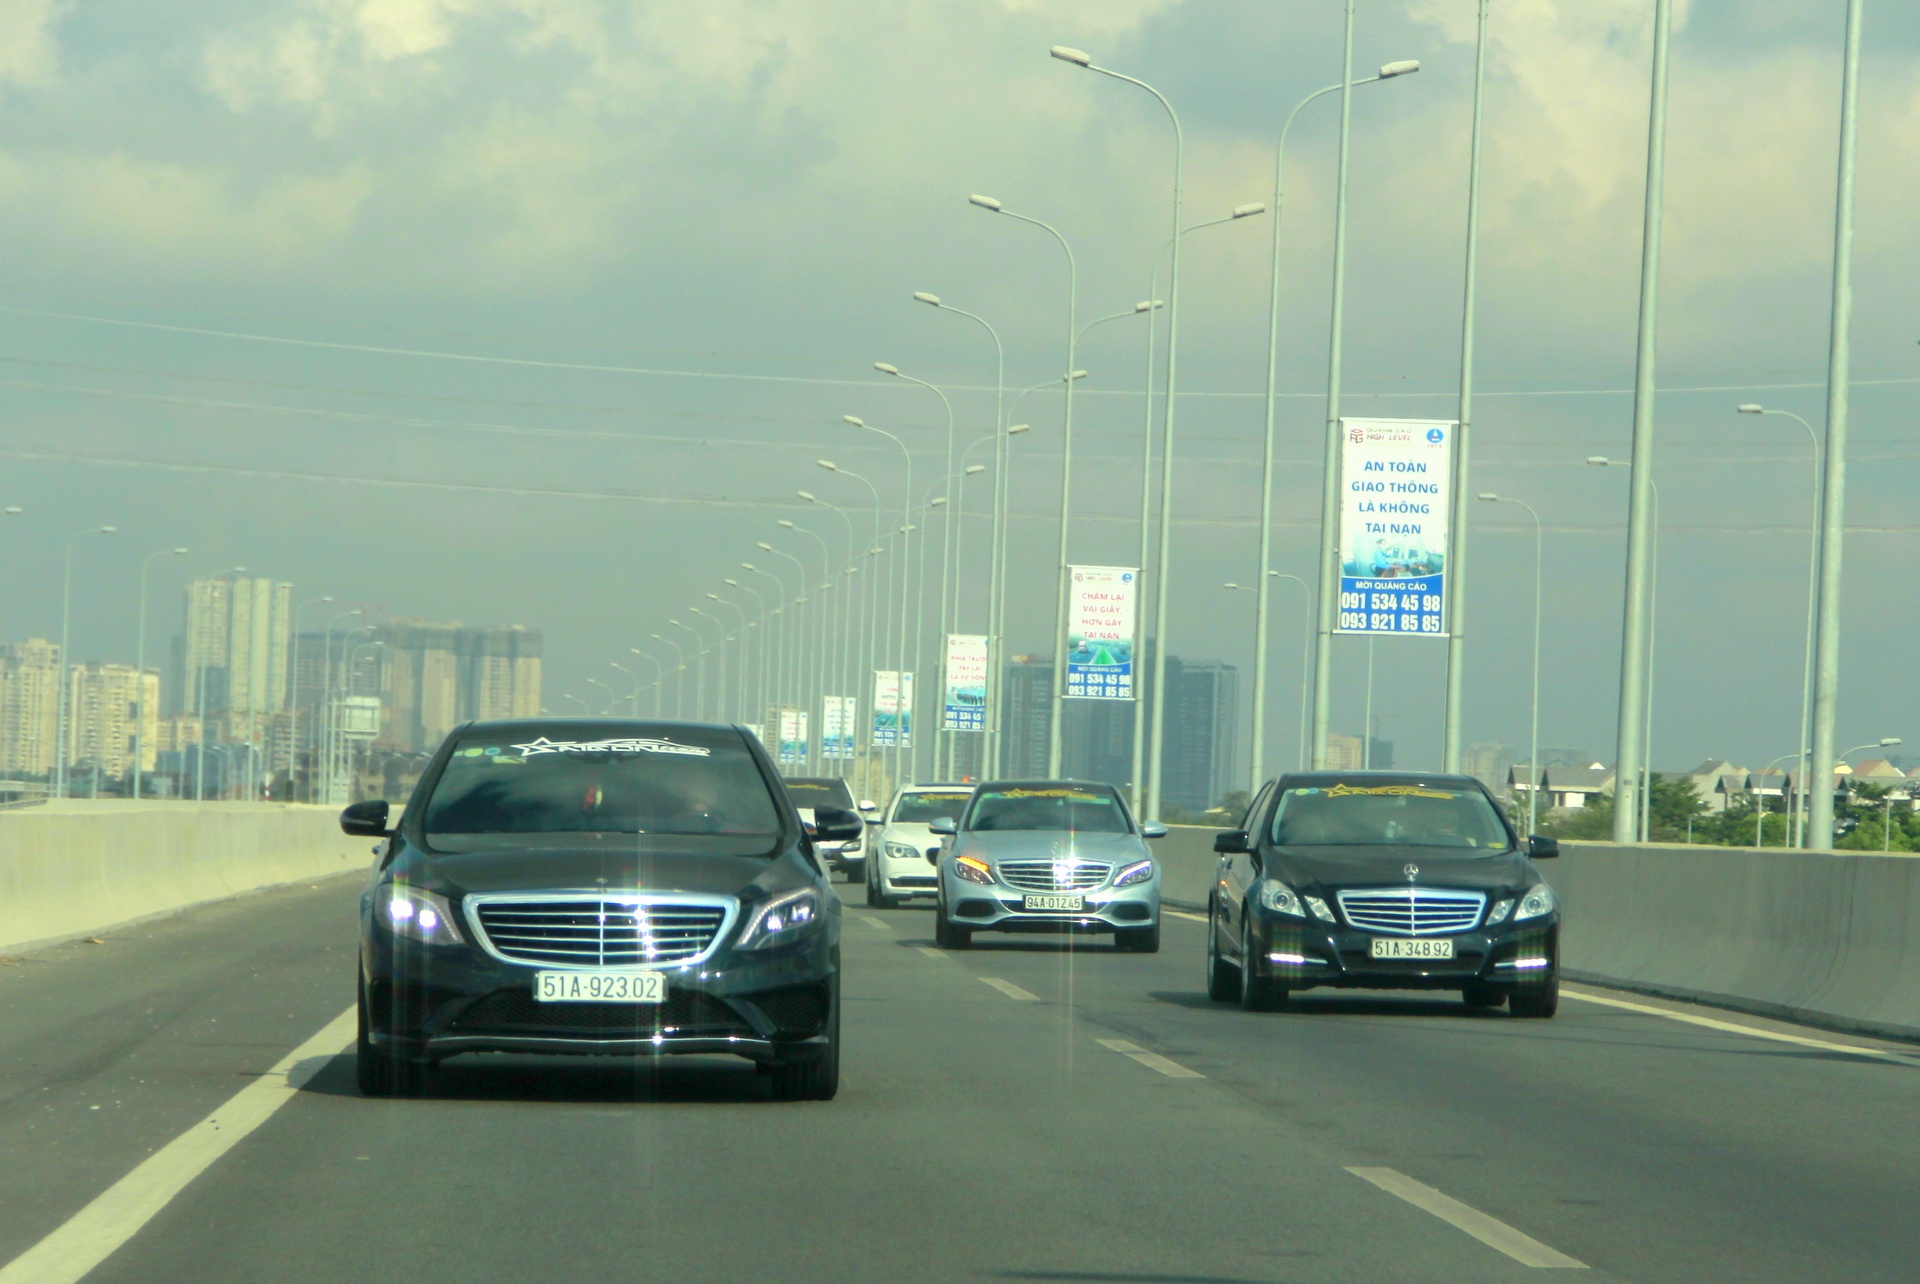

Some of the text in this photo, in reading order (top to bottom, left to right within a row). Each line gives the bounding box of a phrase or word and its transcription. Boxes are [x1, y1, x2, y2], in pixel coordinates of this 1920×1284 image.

[1364, 459, 1427, 473] AN TOÀN
[1351, 480, 1438, 494] GIAO THÔNG
[1358, 499, 1430, 514] LÀ KHÔNG
[1365, 522, 1421, 537] TAI NẠN
[1341, 592, 1441, 612] 091 534 45 98
[1341, 612, 1440, 632] 093 921 85 85
[1083, 631, 1097, 639] TAI
[1069, 673, 1084, 683] 091
[1087, 673, 1104, 684] 534
[543, 975, 657, 999] 51A-923.02
